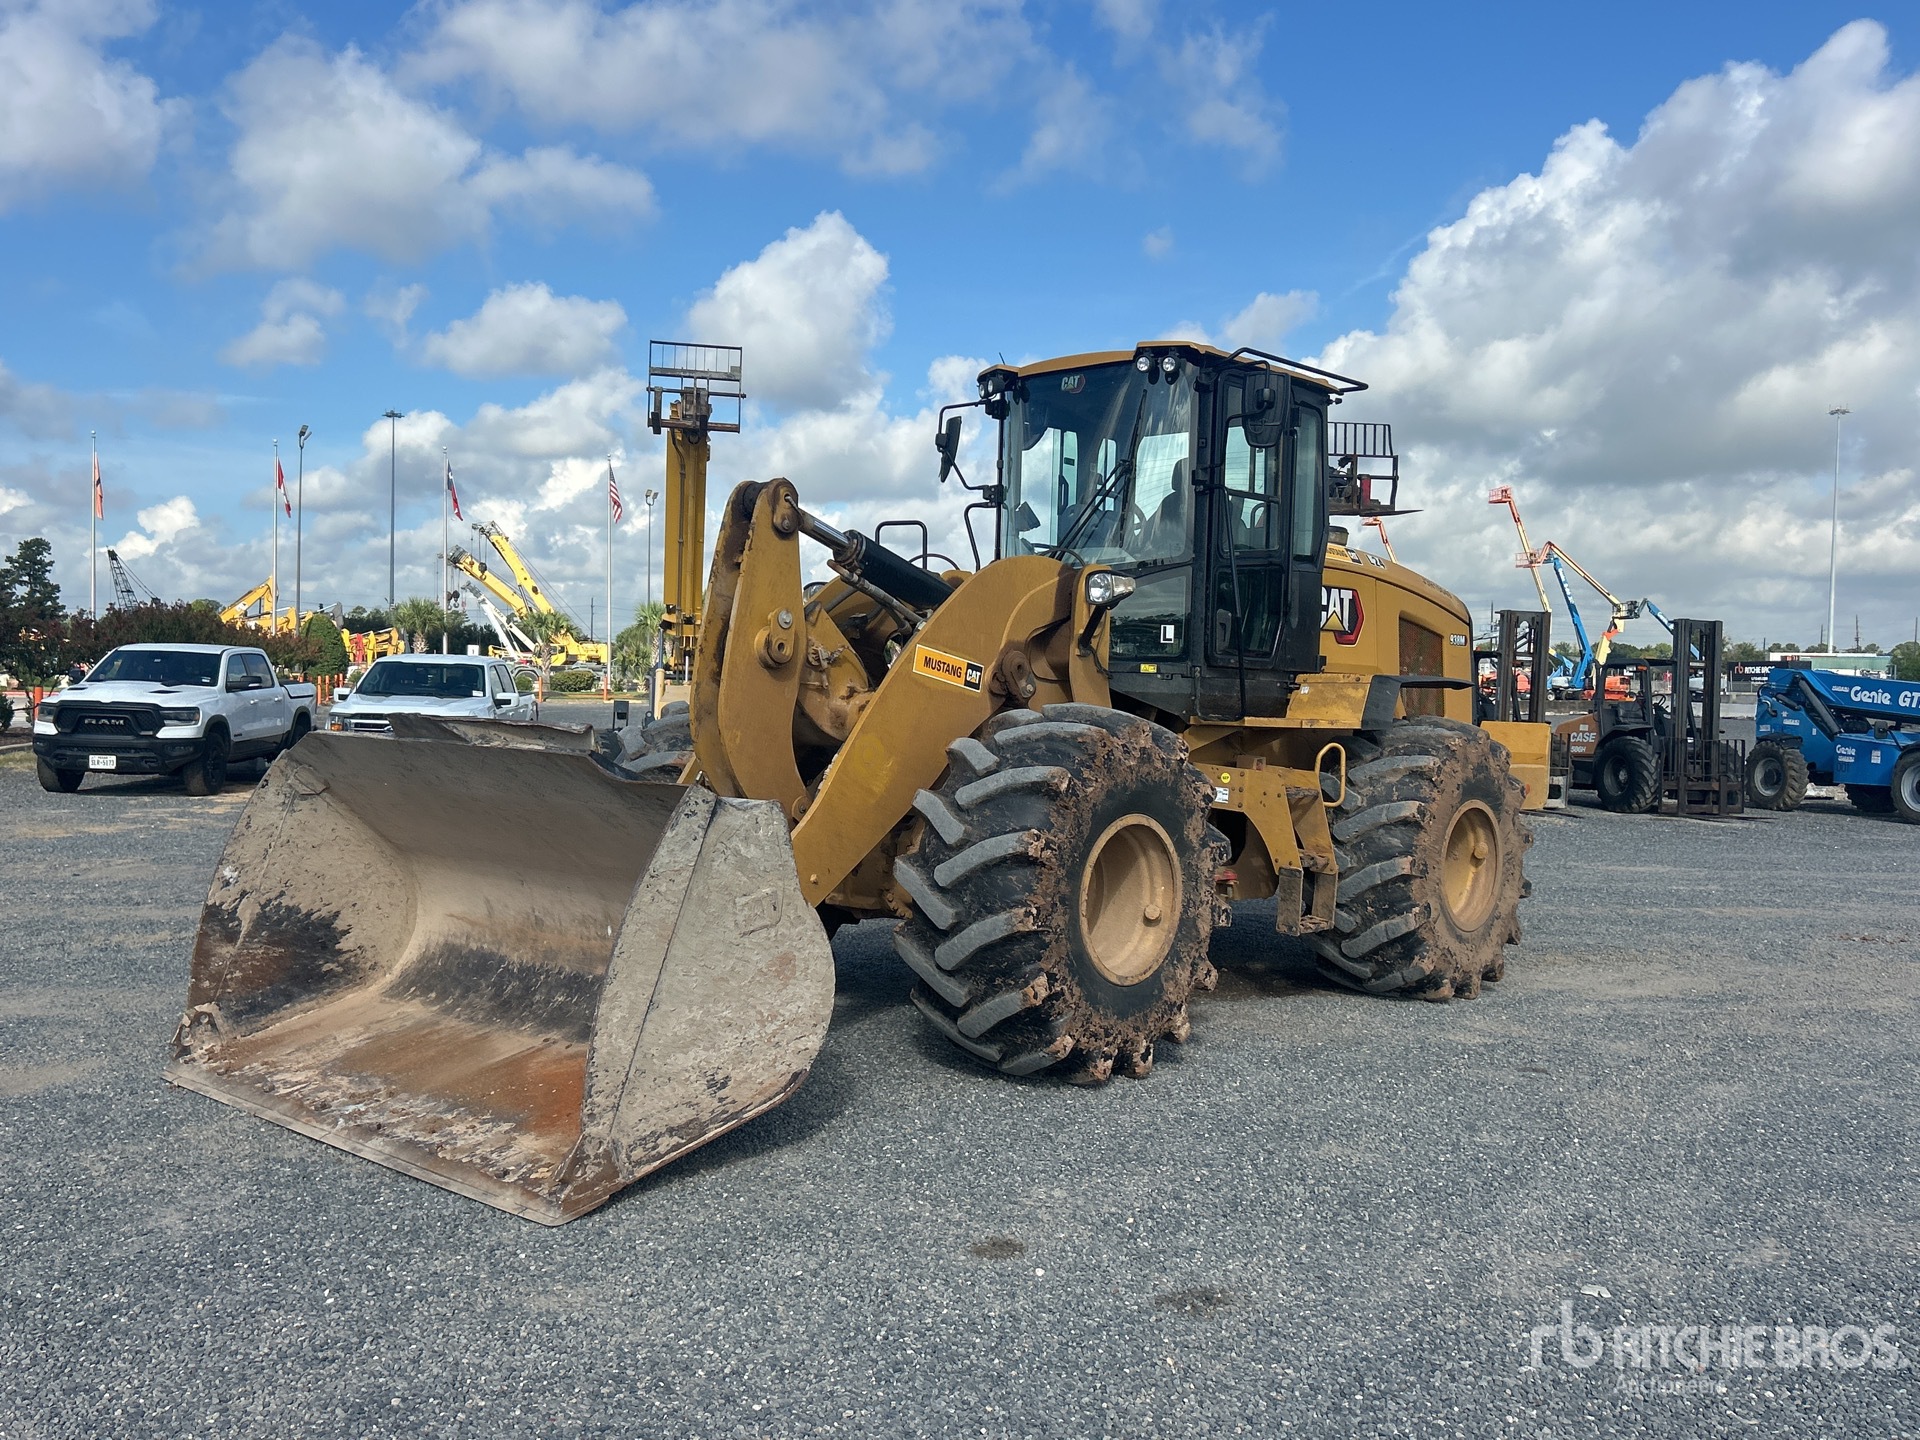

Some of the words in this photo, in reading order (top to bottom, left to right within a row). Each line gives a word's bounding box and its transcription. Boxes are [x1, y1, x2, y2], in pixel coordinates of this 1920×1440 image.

[1061, 375, 1080, 391] CAT
[1162, 625, 1173, 642] L
[923, 656, 963, 679] MUSTANG
[966, 668, 981, 684] CAT
[1850, 685, 1893, 706] Genie
[84, 718, 125, 726] RAM
[1570, 732, 1597, 743] CASE
[1835, 744, 1856, 757] Genie
